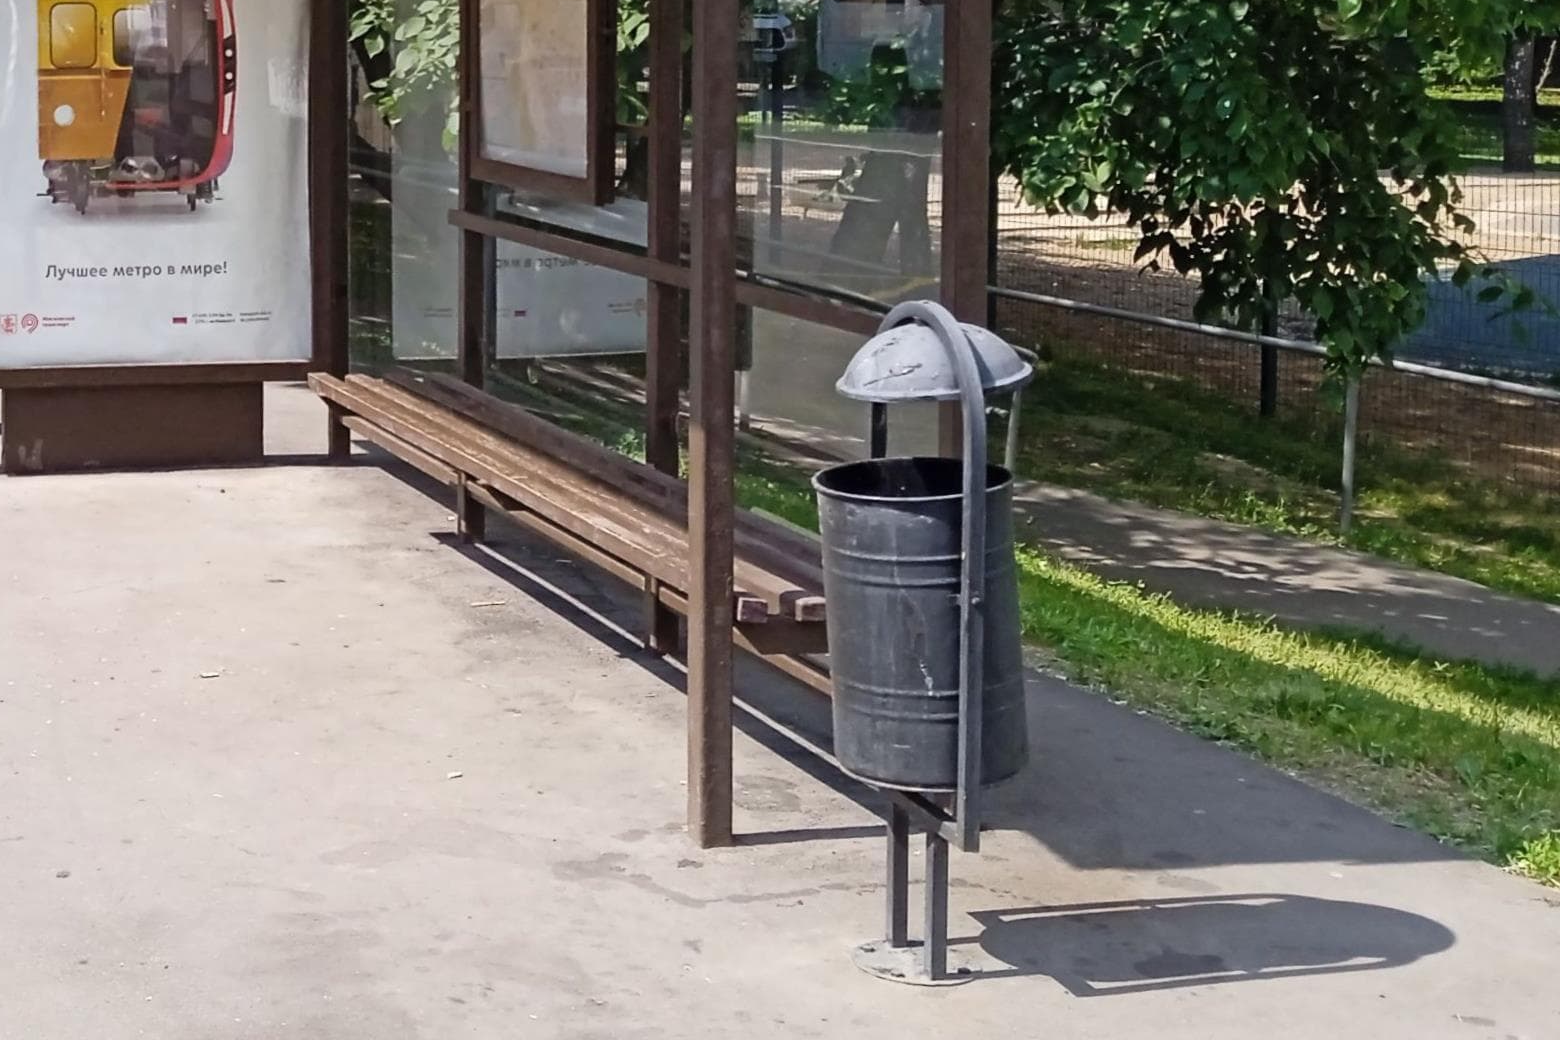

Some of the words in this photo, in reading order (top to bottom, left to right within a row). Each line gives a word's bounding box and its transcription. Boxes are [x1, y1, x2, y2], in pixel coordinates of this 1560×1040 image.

[45, 264, 108, 281] Лучшее
[113, 263, 162, 278] метро
[167, 264, 176, 276] в
[180, 260, 229, 278] мире!
